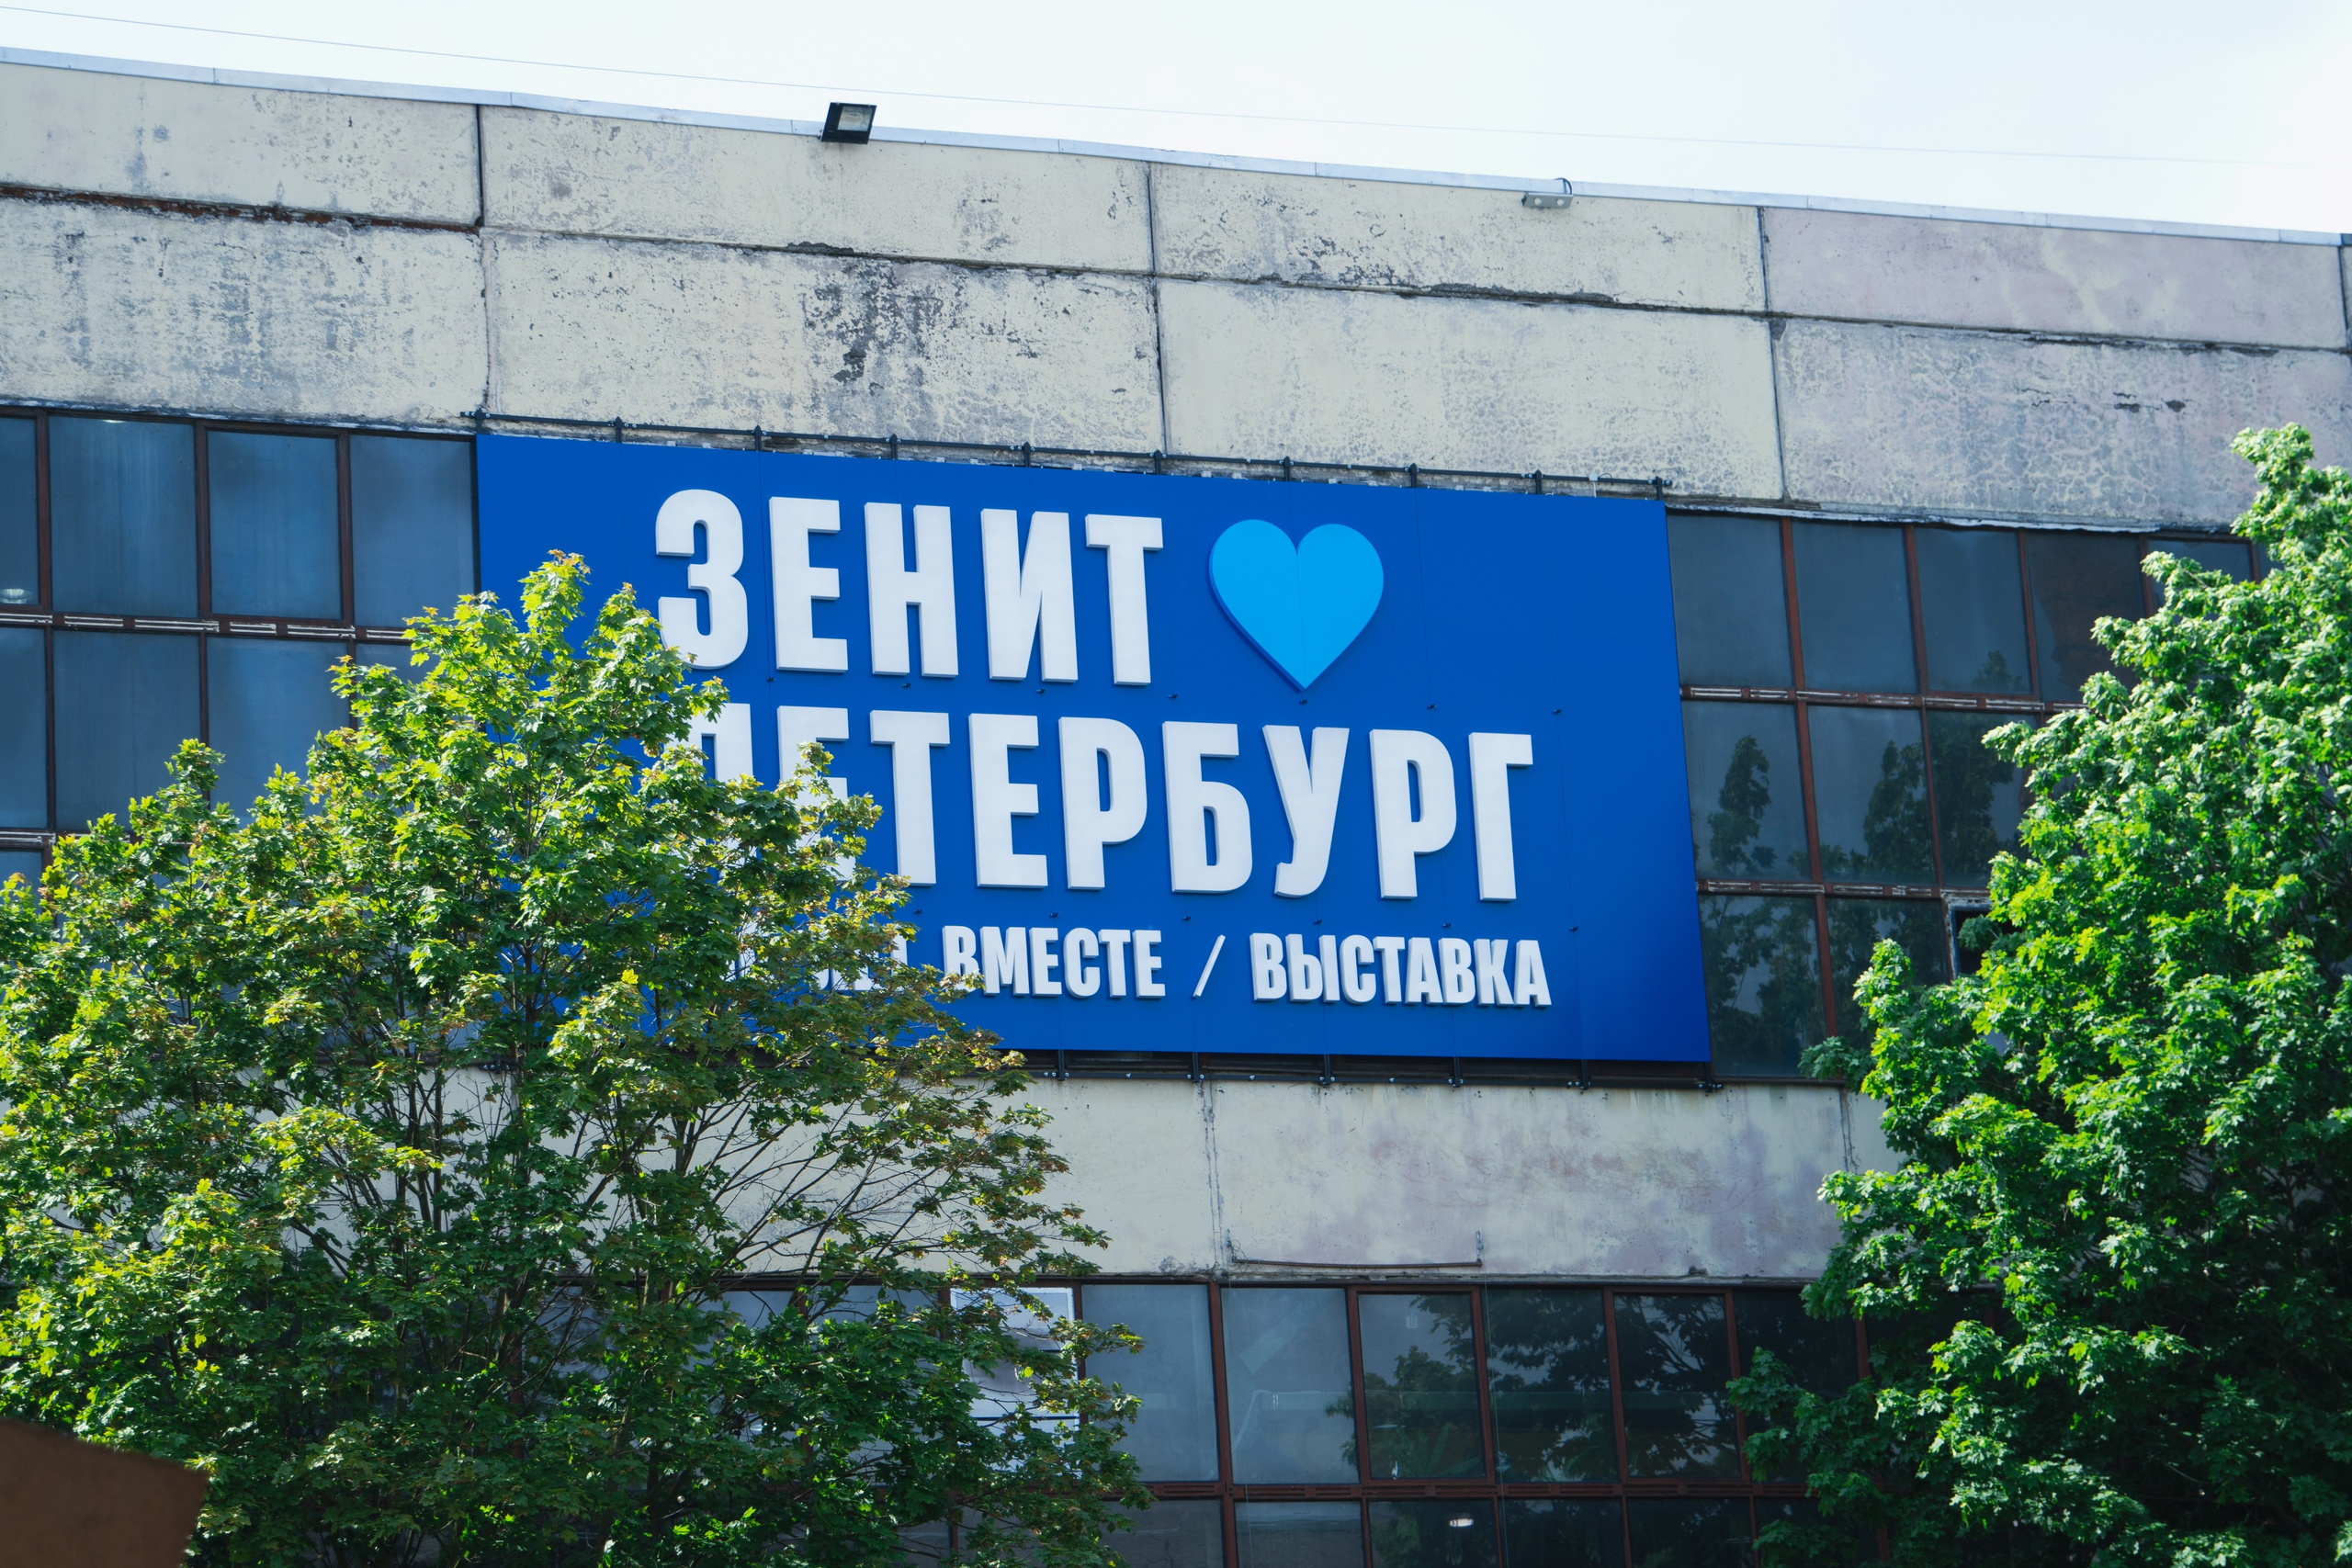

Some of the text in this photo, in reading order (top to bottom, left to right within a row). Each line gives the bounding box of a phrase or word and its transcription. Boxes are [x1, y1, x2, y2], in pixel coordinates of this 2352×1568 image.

[655, 489, 1163, 686] ЗЕНИТ
[942, 925, 1166, 998] ВМЕСТЕ
[1193, 934, 1226, 998] /
[1250, 932, 1552, 1007] ВЫСТАВКА
